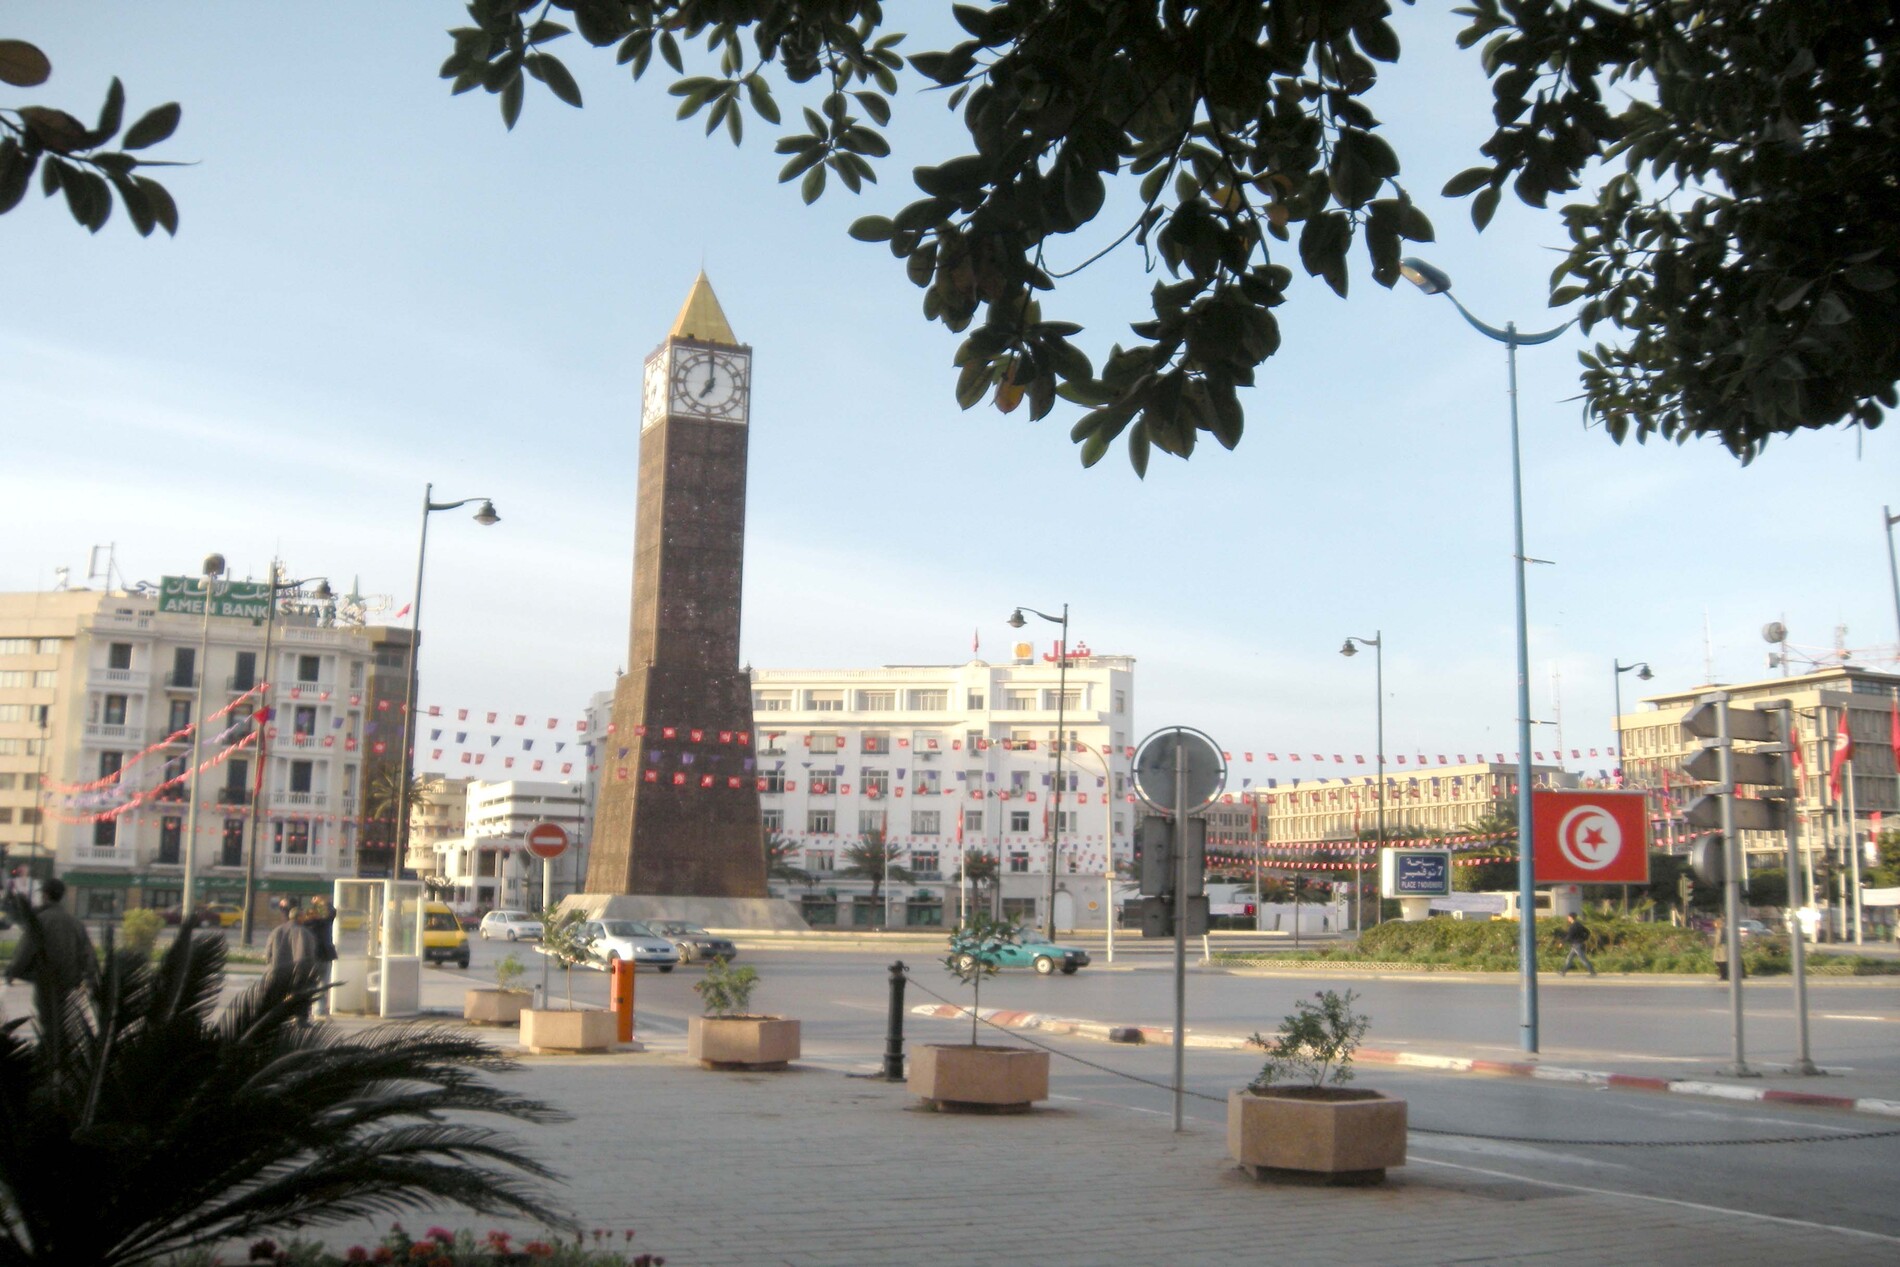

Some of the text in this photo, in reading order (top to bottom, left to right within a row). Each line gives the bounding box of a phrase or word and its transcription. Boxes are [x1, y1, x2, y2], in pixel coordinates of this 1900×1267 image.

[164, 598, 269, 618] AMEN BANK
[280, 602, 337, 619] STAR
[1406, 857, 1436, 867] ساحة
[1401, 865, 1444, 879] 7 نوفمبر
[1401, 881, 1417, 889] PLACE
